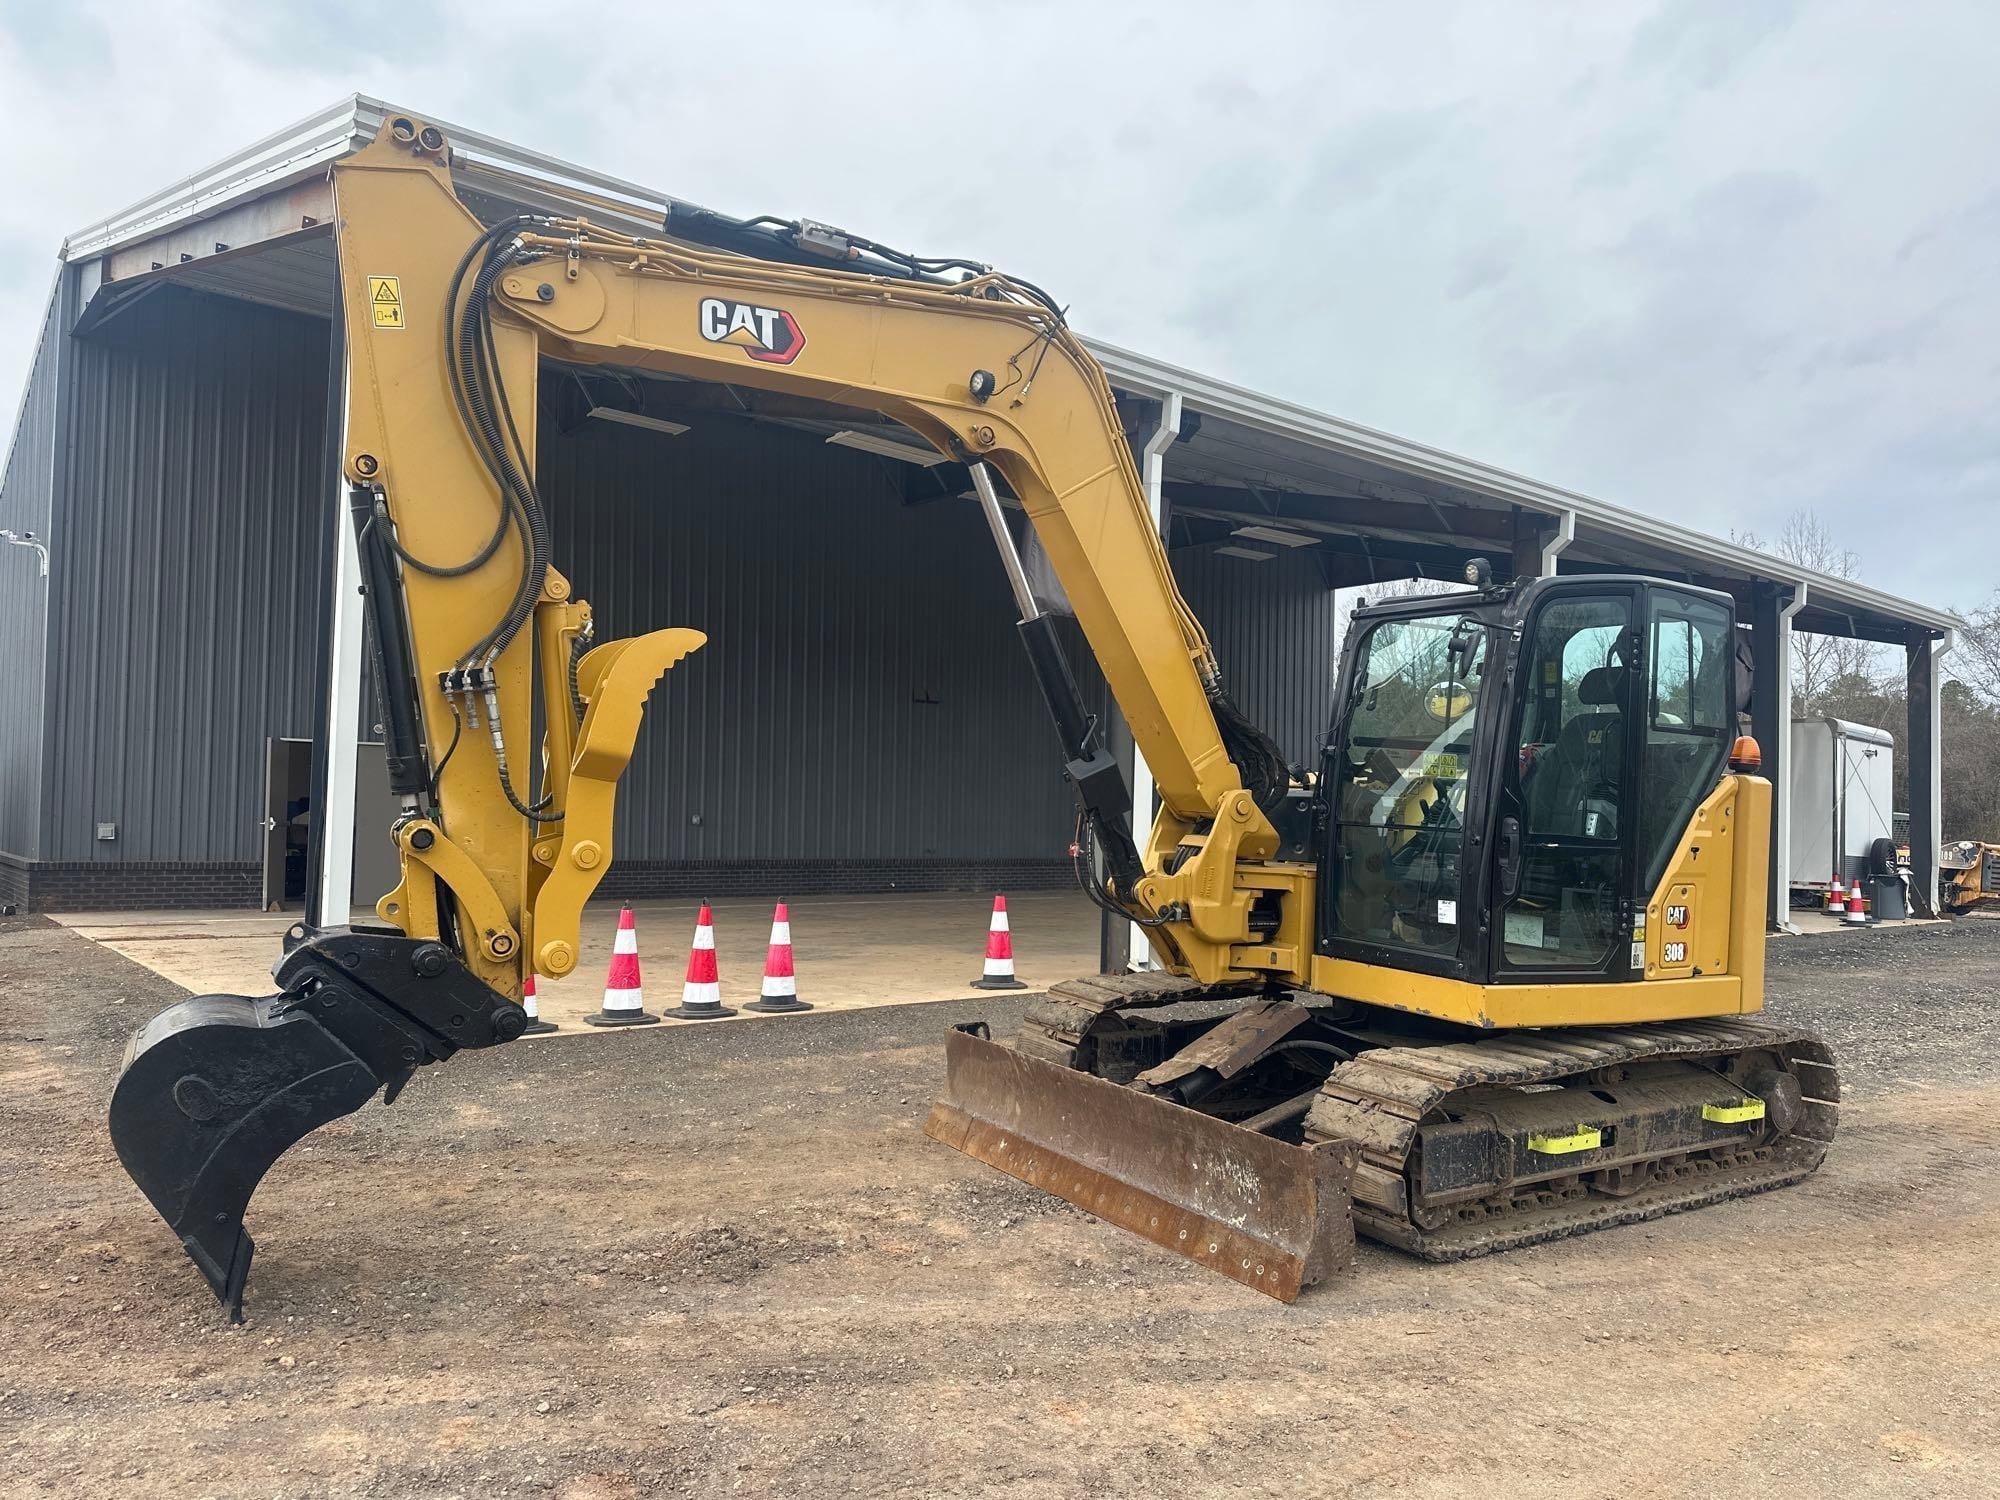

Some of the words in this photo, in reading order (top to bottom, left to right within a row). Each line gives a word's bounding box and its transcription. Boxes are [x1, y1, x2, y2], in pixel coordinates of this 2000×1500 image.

[701, 298, 779, 350] CAT
[1587, 729, 1603, 744] CA
[1667, 906, 1686, 925] CAT
[1664, 943, 1684, 962] 308
